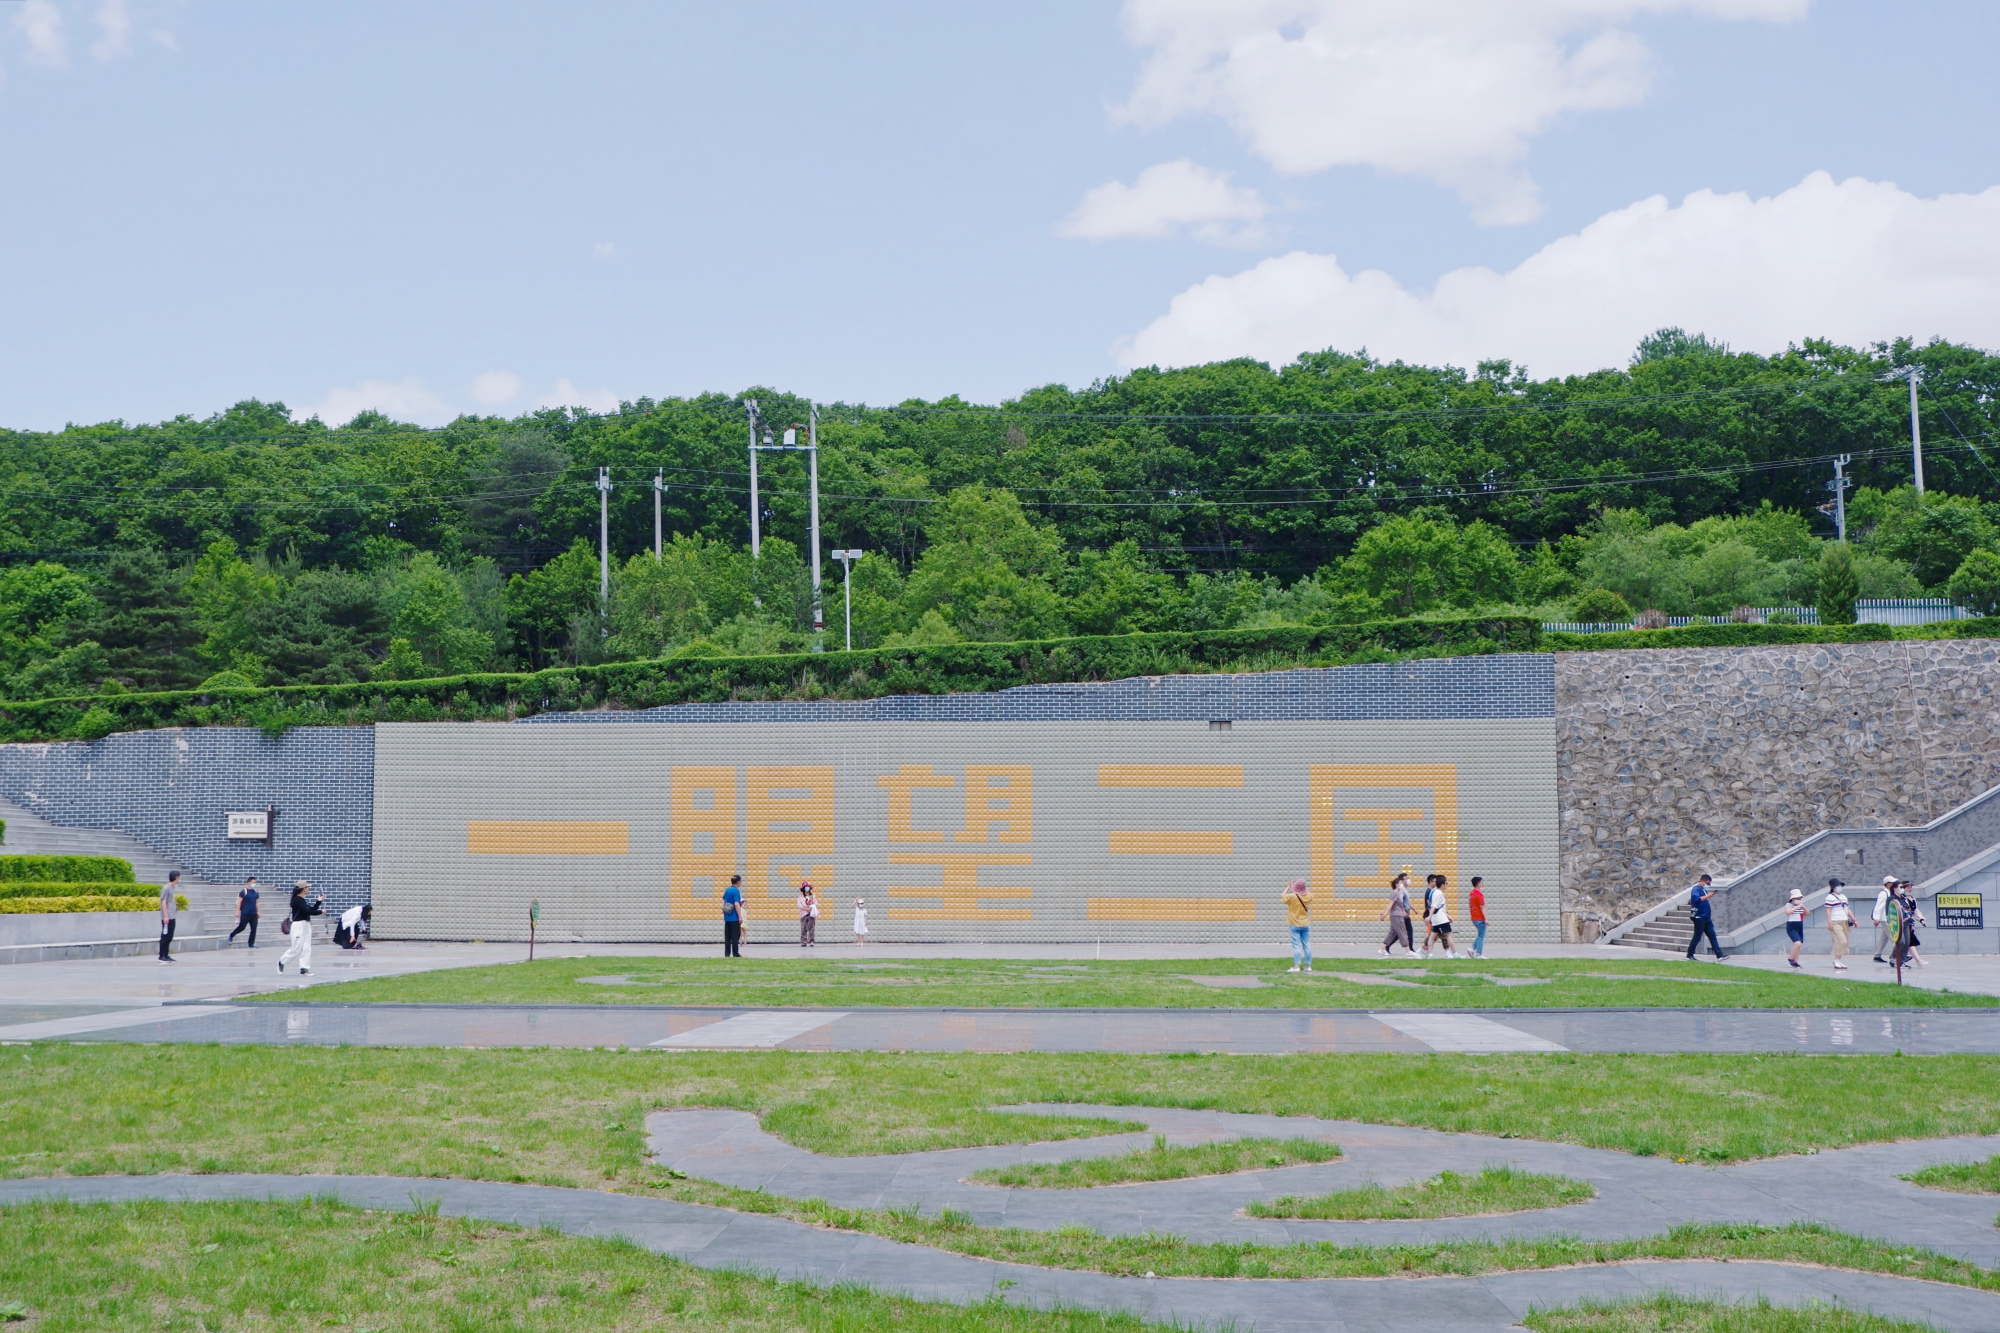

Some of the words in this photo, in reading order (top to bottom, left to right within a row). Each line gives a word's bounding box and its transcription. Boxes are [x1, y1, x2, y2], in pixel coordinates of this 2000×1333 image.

[468, 763, 1457, 922] 一眼望三国
